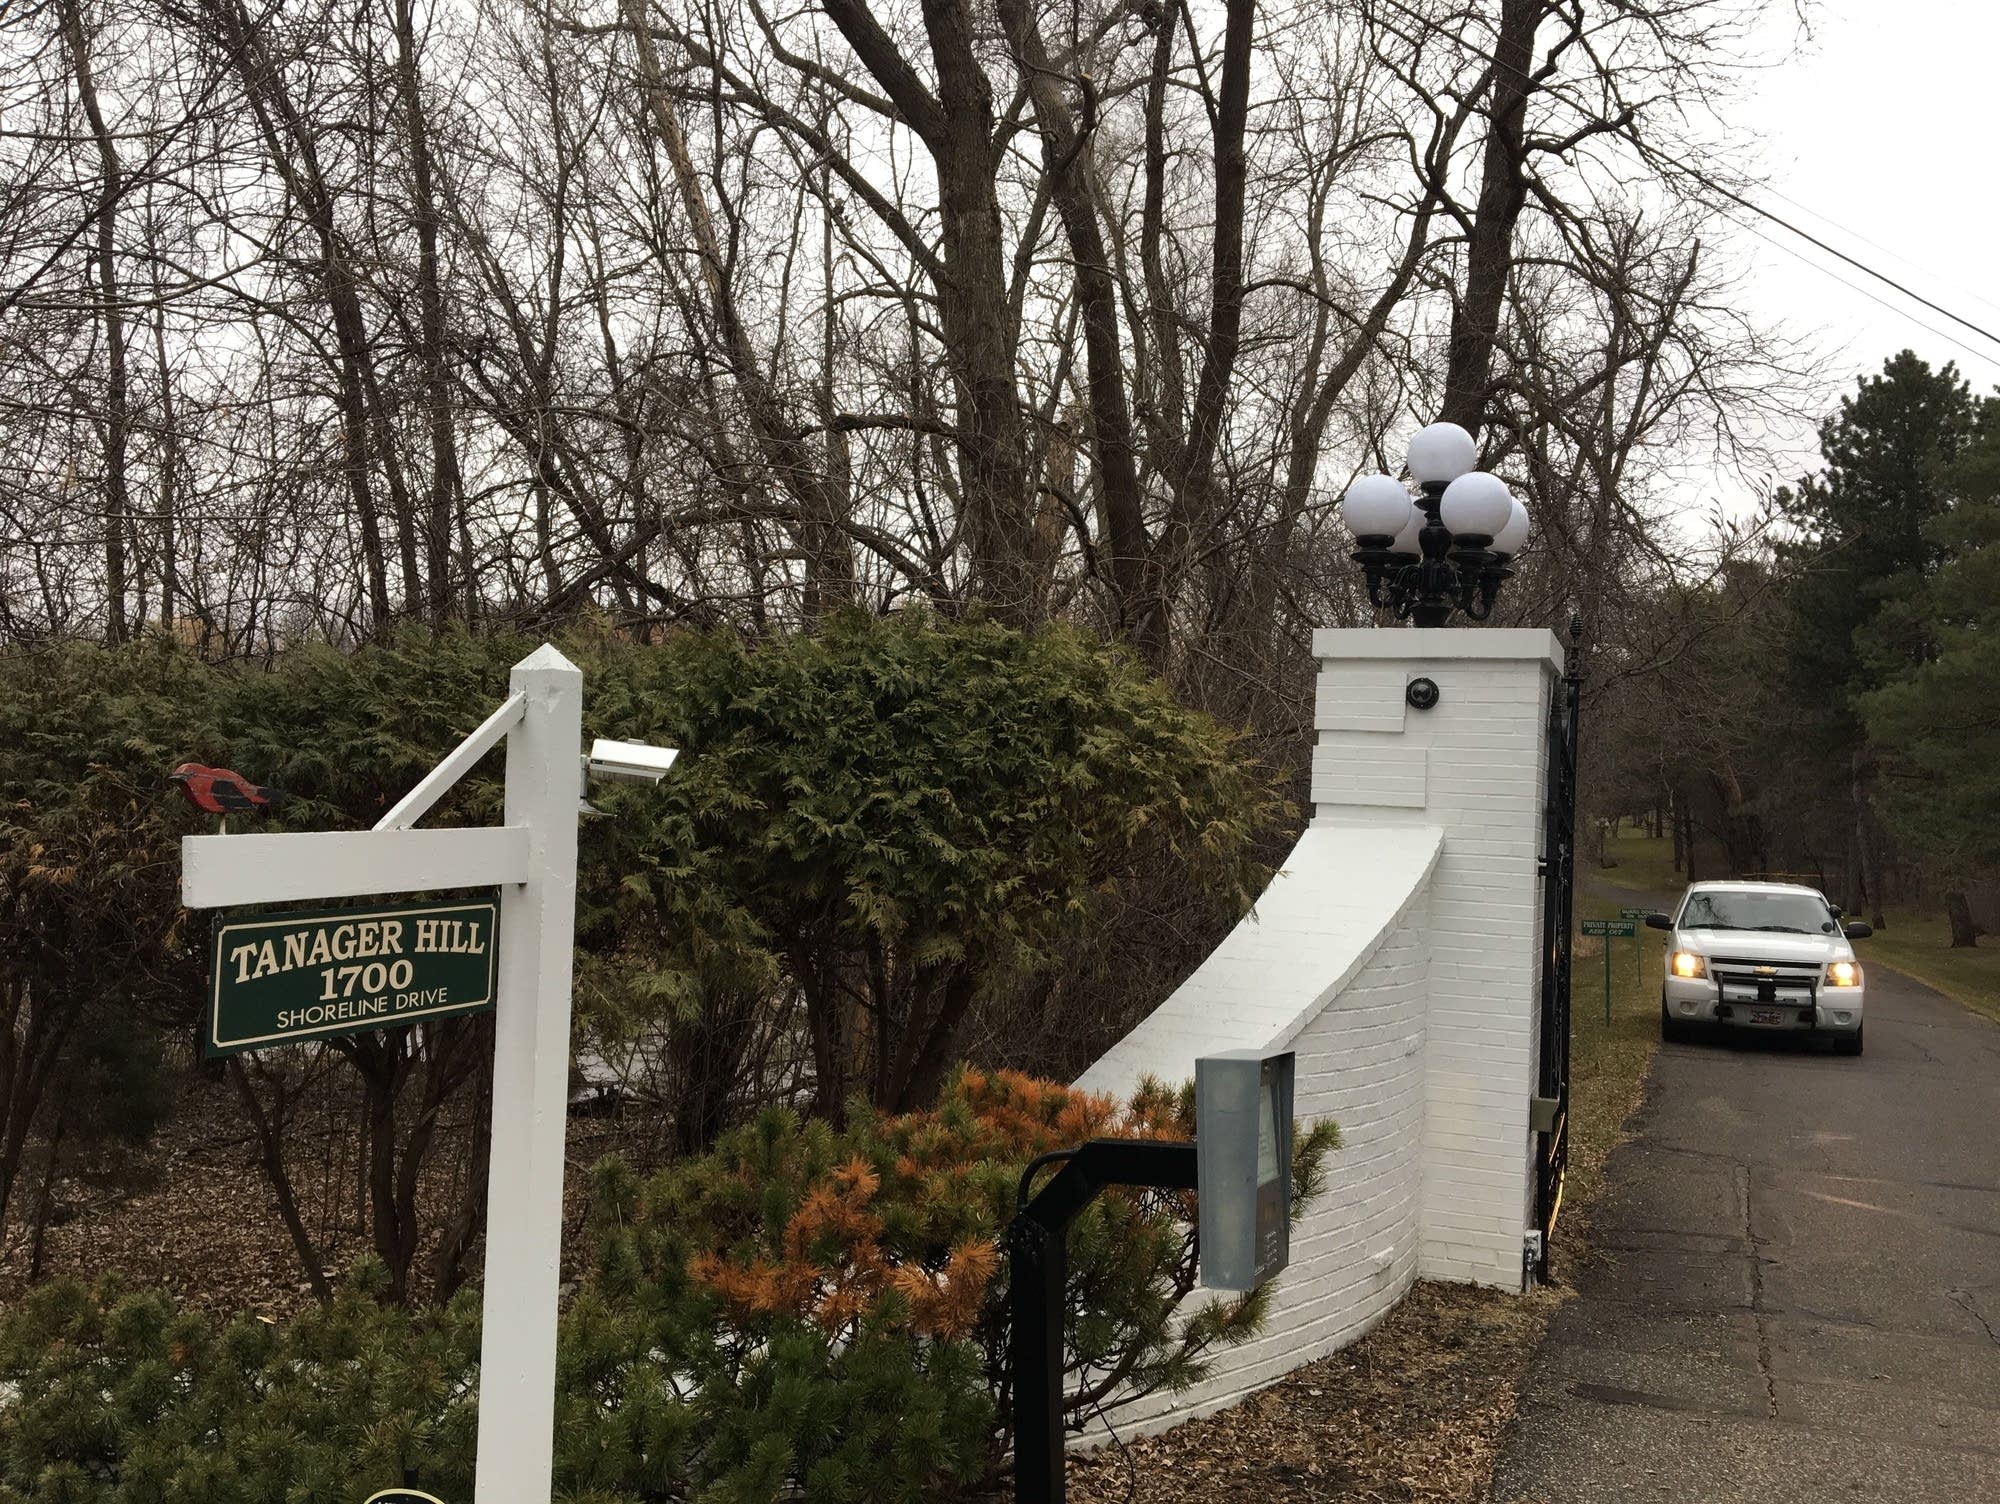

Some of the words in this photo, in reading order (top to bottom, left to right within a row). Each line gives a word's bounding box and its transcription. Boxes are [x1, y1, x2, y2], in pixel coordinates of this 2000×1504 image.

[229, 920, 404, 985] TANAGER
[414, 919, 485, 955] HILL
[319, 959, 414, 1001] 1700
[276, 996, 388, 1029] SHORELINE
[395, 987, 448, 1011] DRIVE
